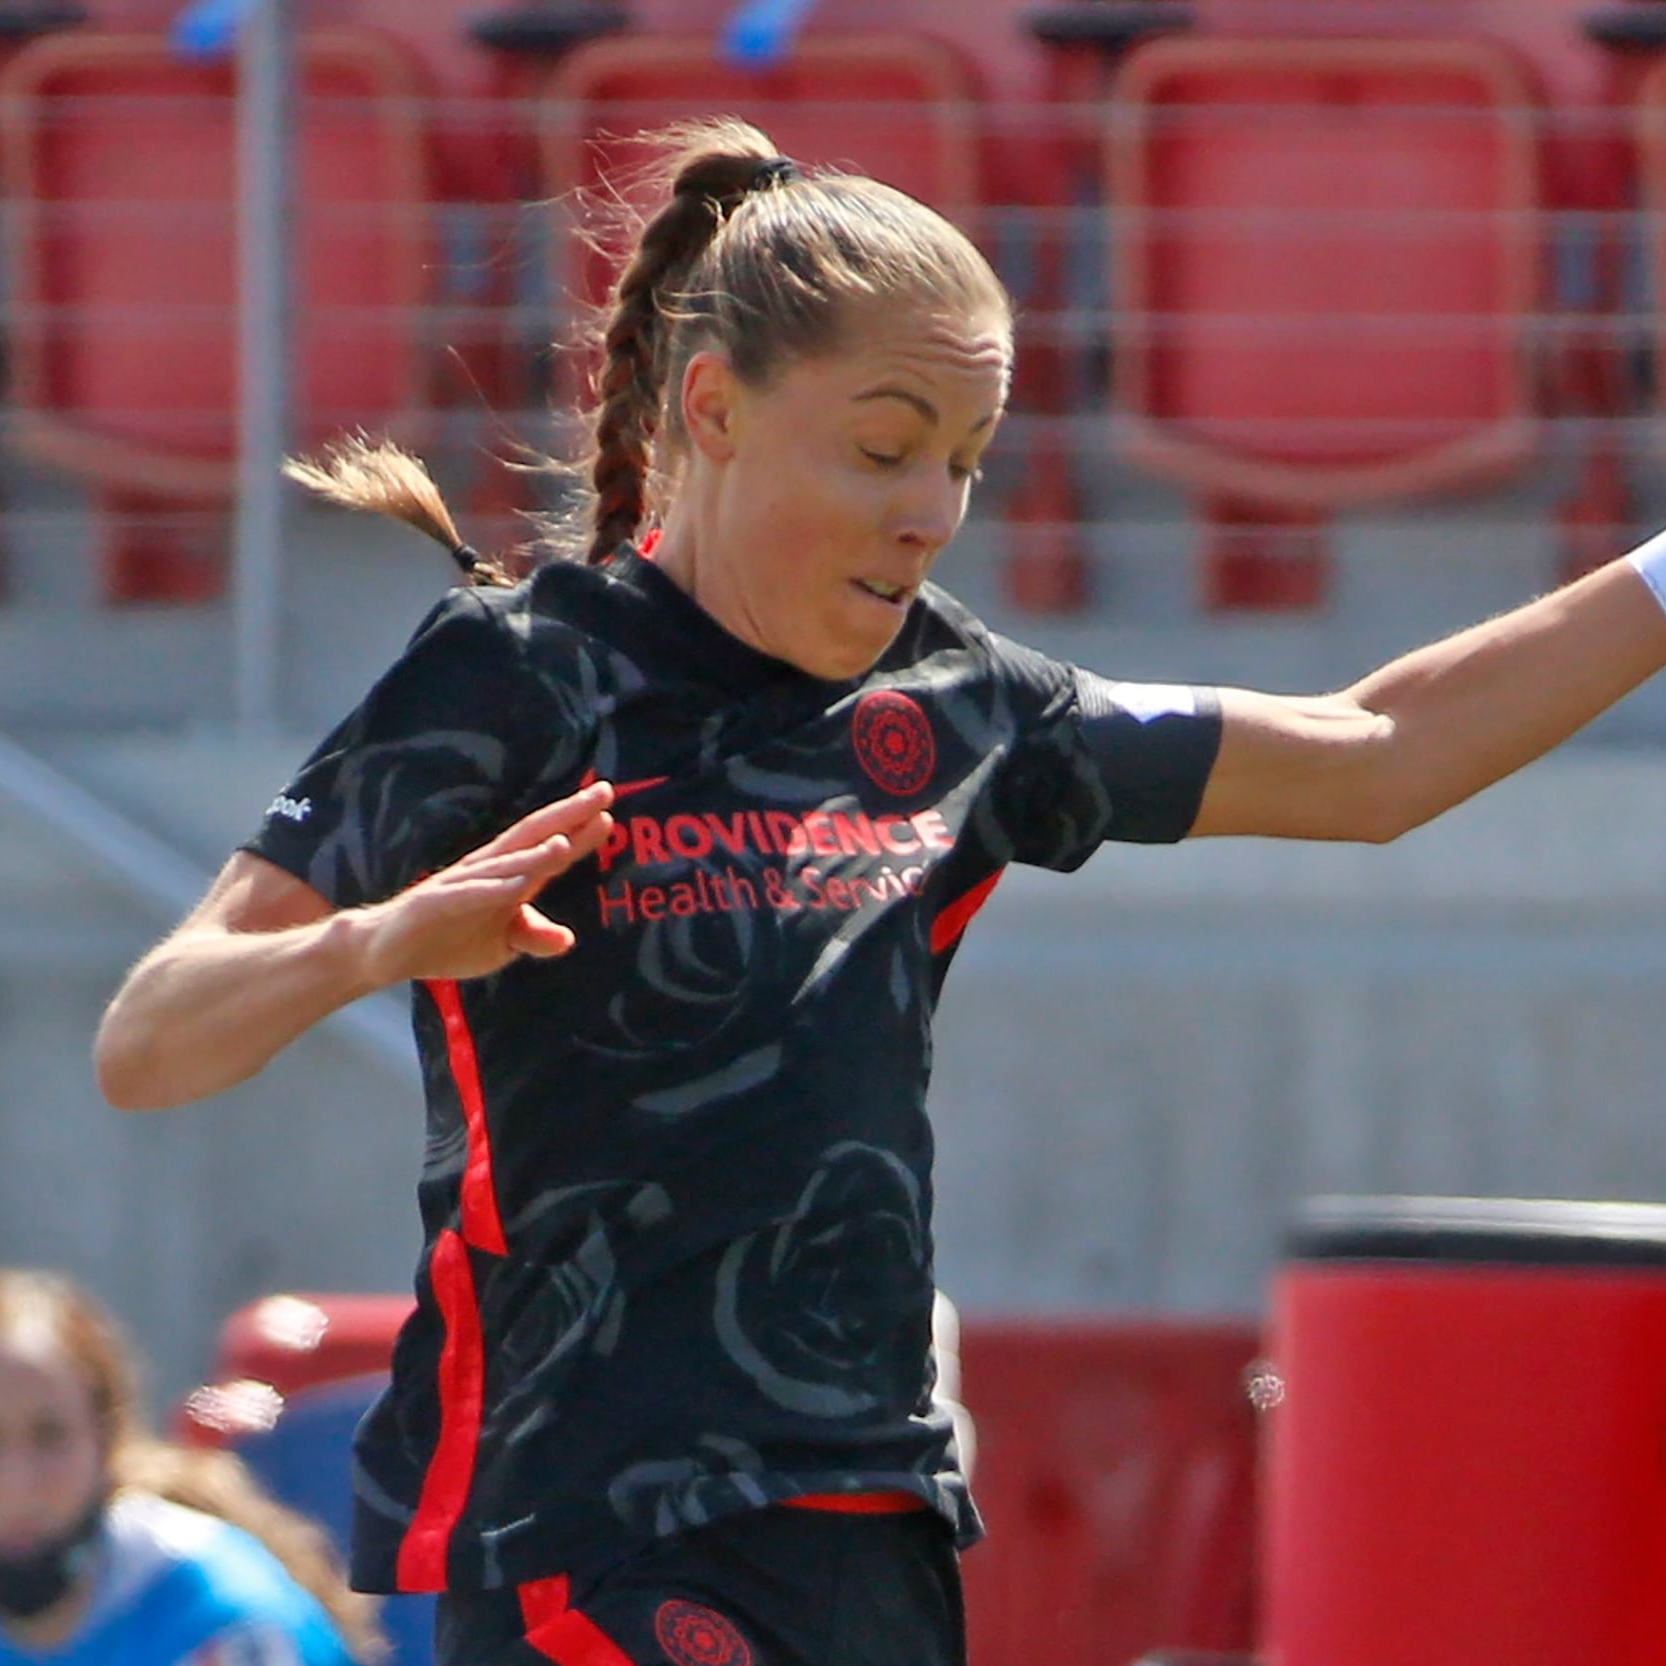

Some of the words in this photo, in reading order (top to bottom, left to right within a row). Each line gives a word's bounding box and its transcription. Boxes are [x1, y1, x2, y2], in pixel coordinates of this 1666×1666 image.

[597, 808, 955, 872] PROVIDENCE
[597, 866, 758, 928] Health
[764, 867, 801, 910] &
[800, 860, 927, 909] Servic
